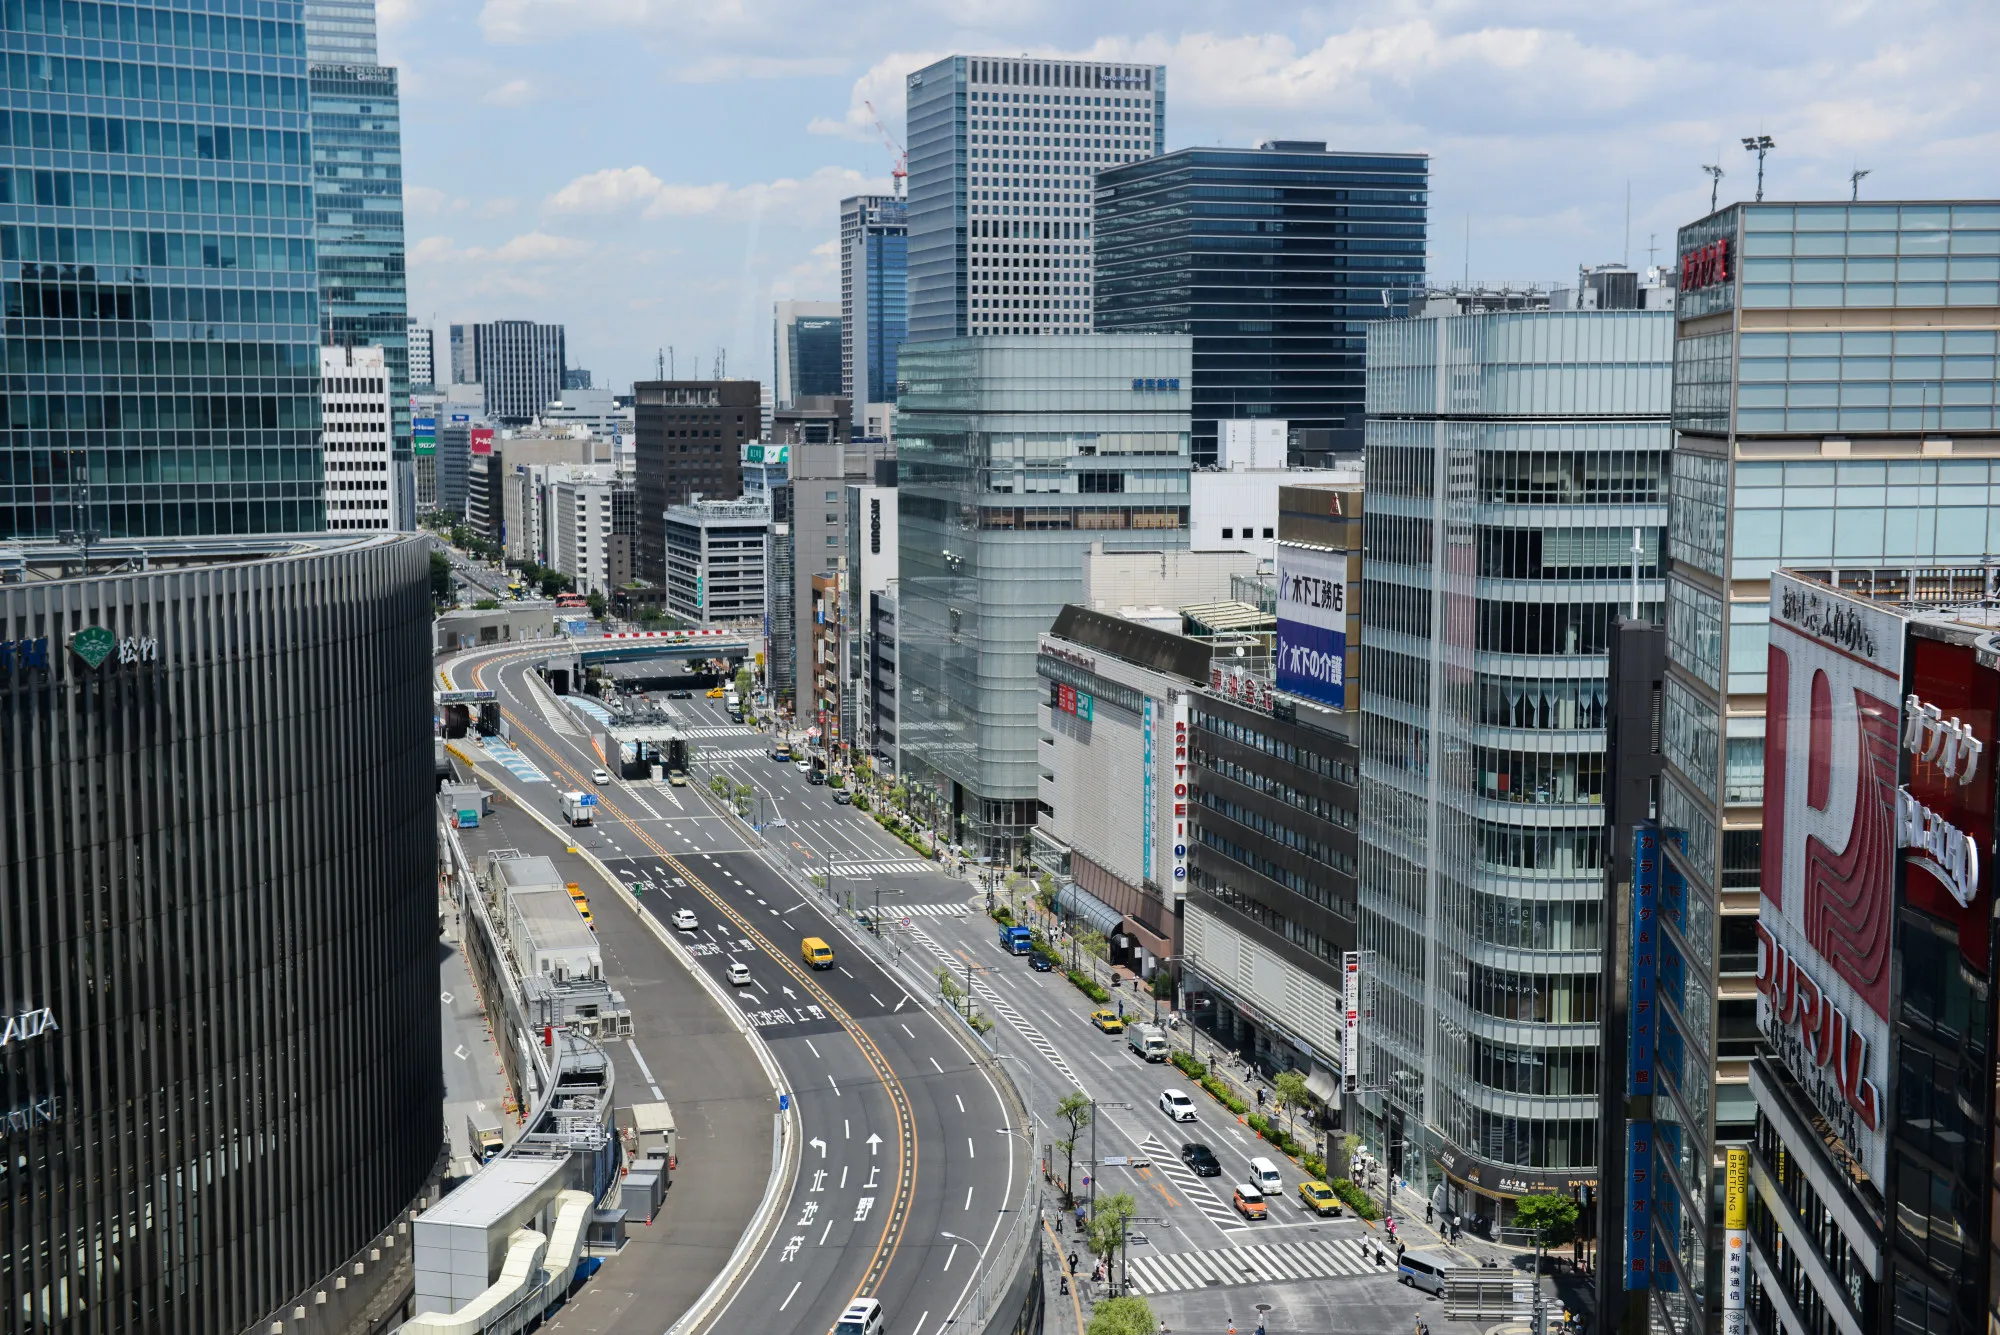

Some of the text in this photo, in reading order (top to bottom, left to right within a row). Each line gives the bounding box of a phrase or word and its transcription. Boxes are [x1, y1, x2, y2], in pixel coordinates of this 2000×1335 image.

[870, 498, 881, 555] JOYSOUND
[1292, 575, 1343, 613] 木下工務店
[118, 636, 159, 664] 松竹
[1290, 644, 1343, 687] 木下の介護
[1175, 720, 1187, 760] 丸の内
[1903, 694, 1983, 787] カラオケ
[747, 1004, 827, 1026] 北池袋 上野
[1481, 1045, 1543, 1066] DIESEL
[1728, 1155, 1737, 1212] BREITLING
[1737, 1155, 1745, 1194] STUDIO
[1630, 1139, 1648, 1274] カラオケ館
[1729, 1252, 1740, 1301] 新東通信
